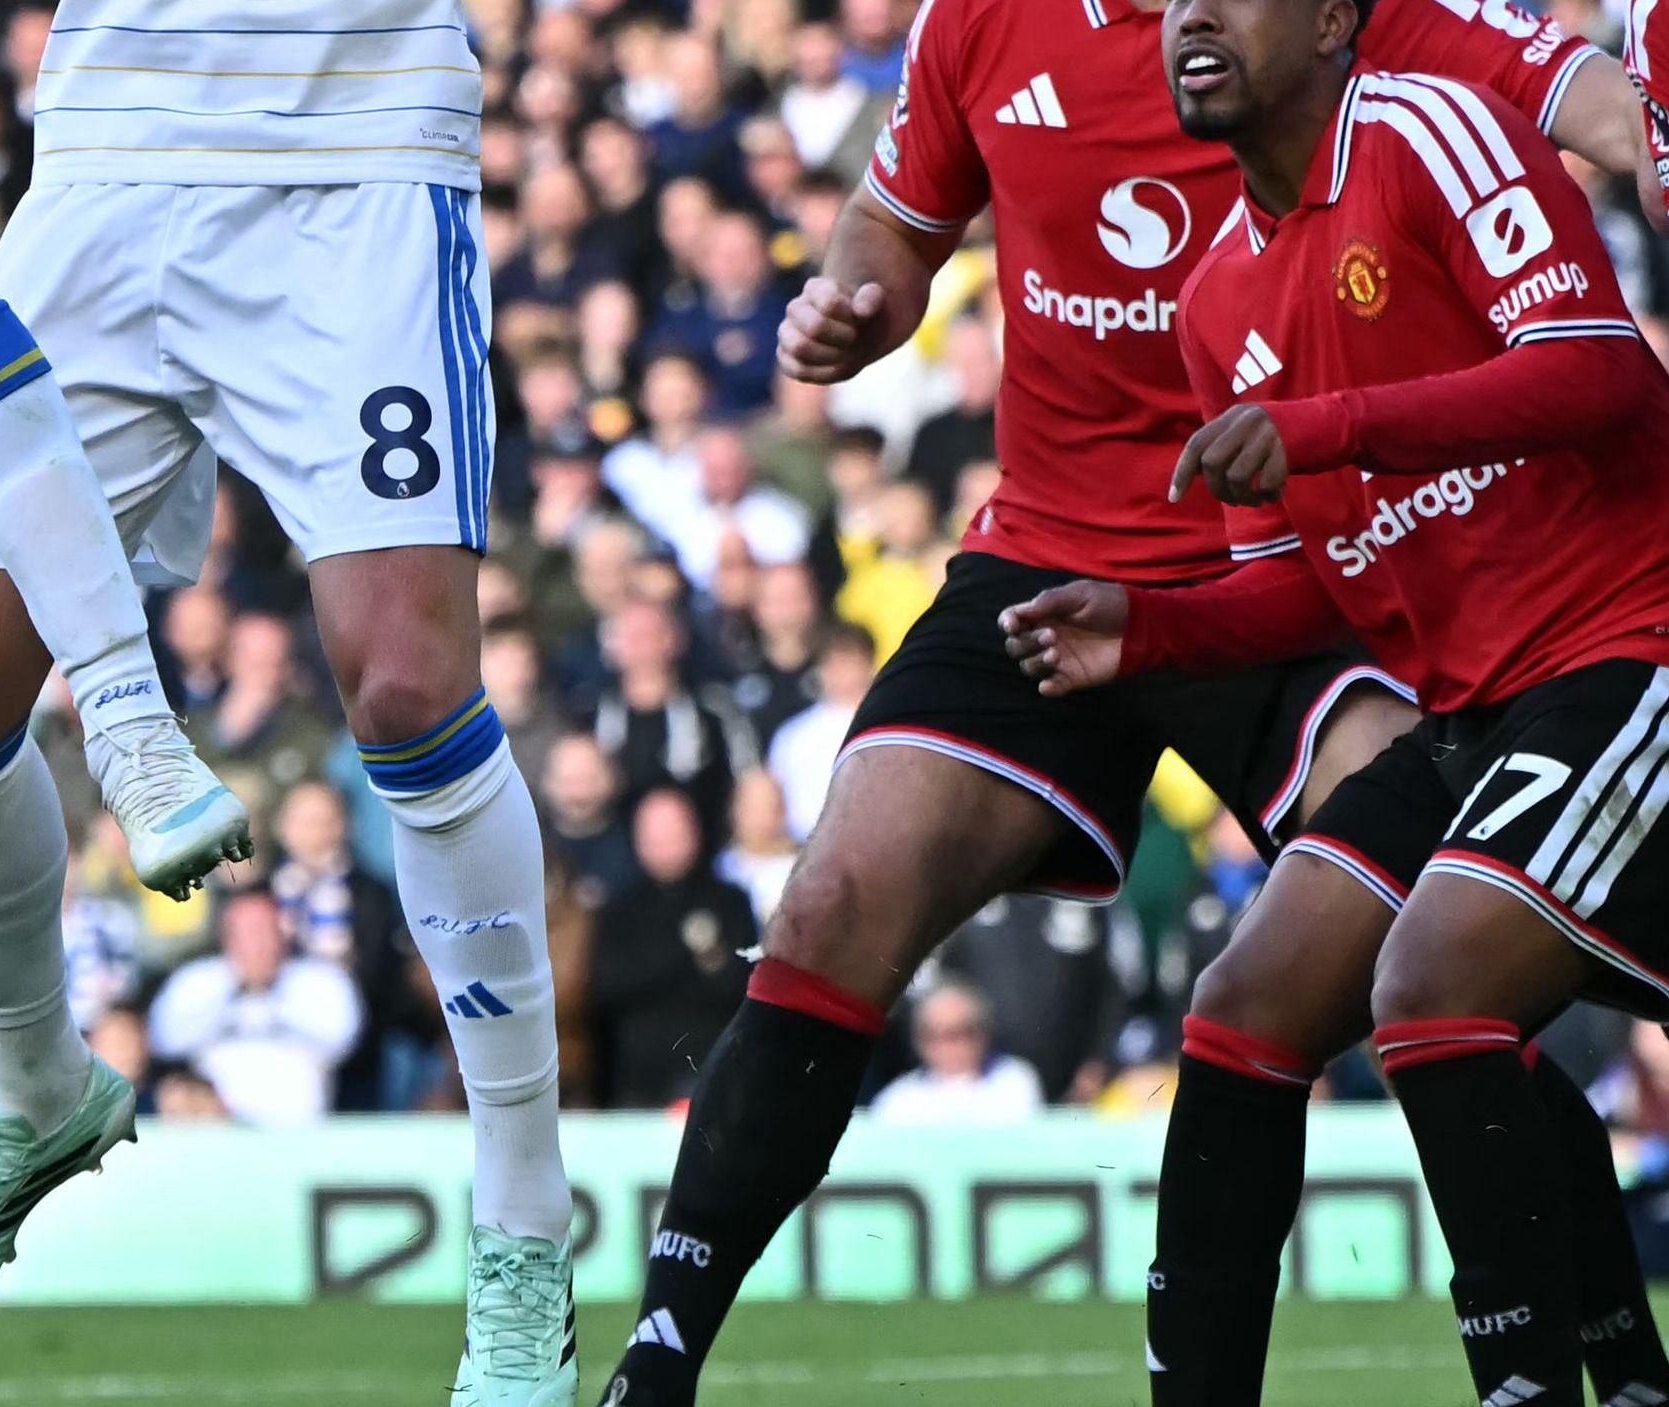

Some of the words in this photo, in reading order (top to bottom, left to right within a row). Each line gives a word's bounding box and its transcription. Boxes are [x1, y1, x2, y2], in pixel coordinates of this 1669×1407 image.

[1023, 267, 1177, 341] Snapdr
[1487, 261, 1589, 334] sumup
[359, 385, 441, 500] 8
[1442, 752, 1573, 842] 17
